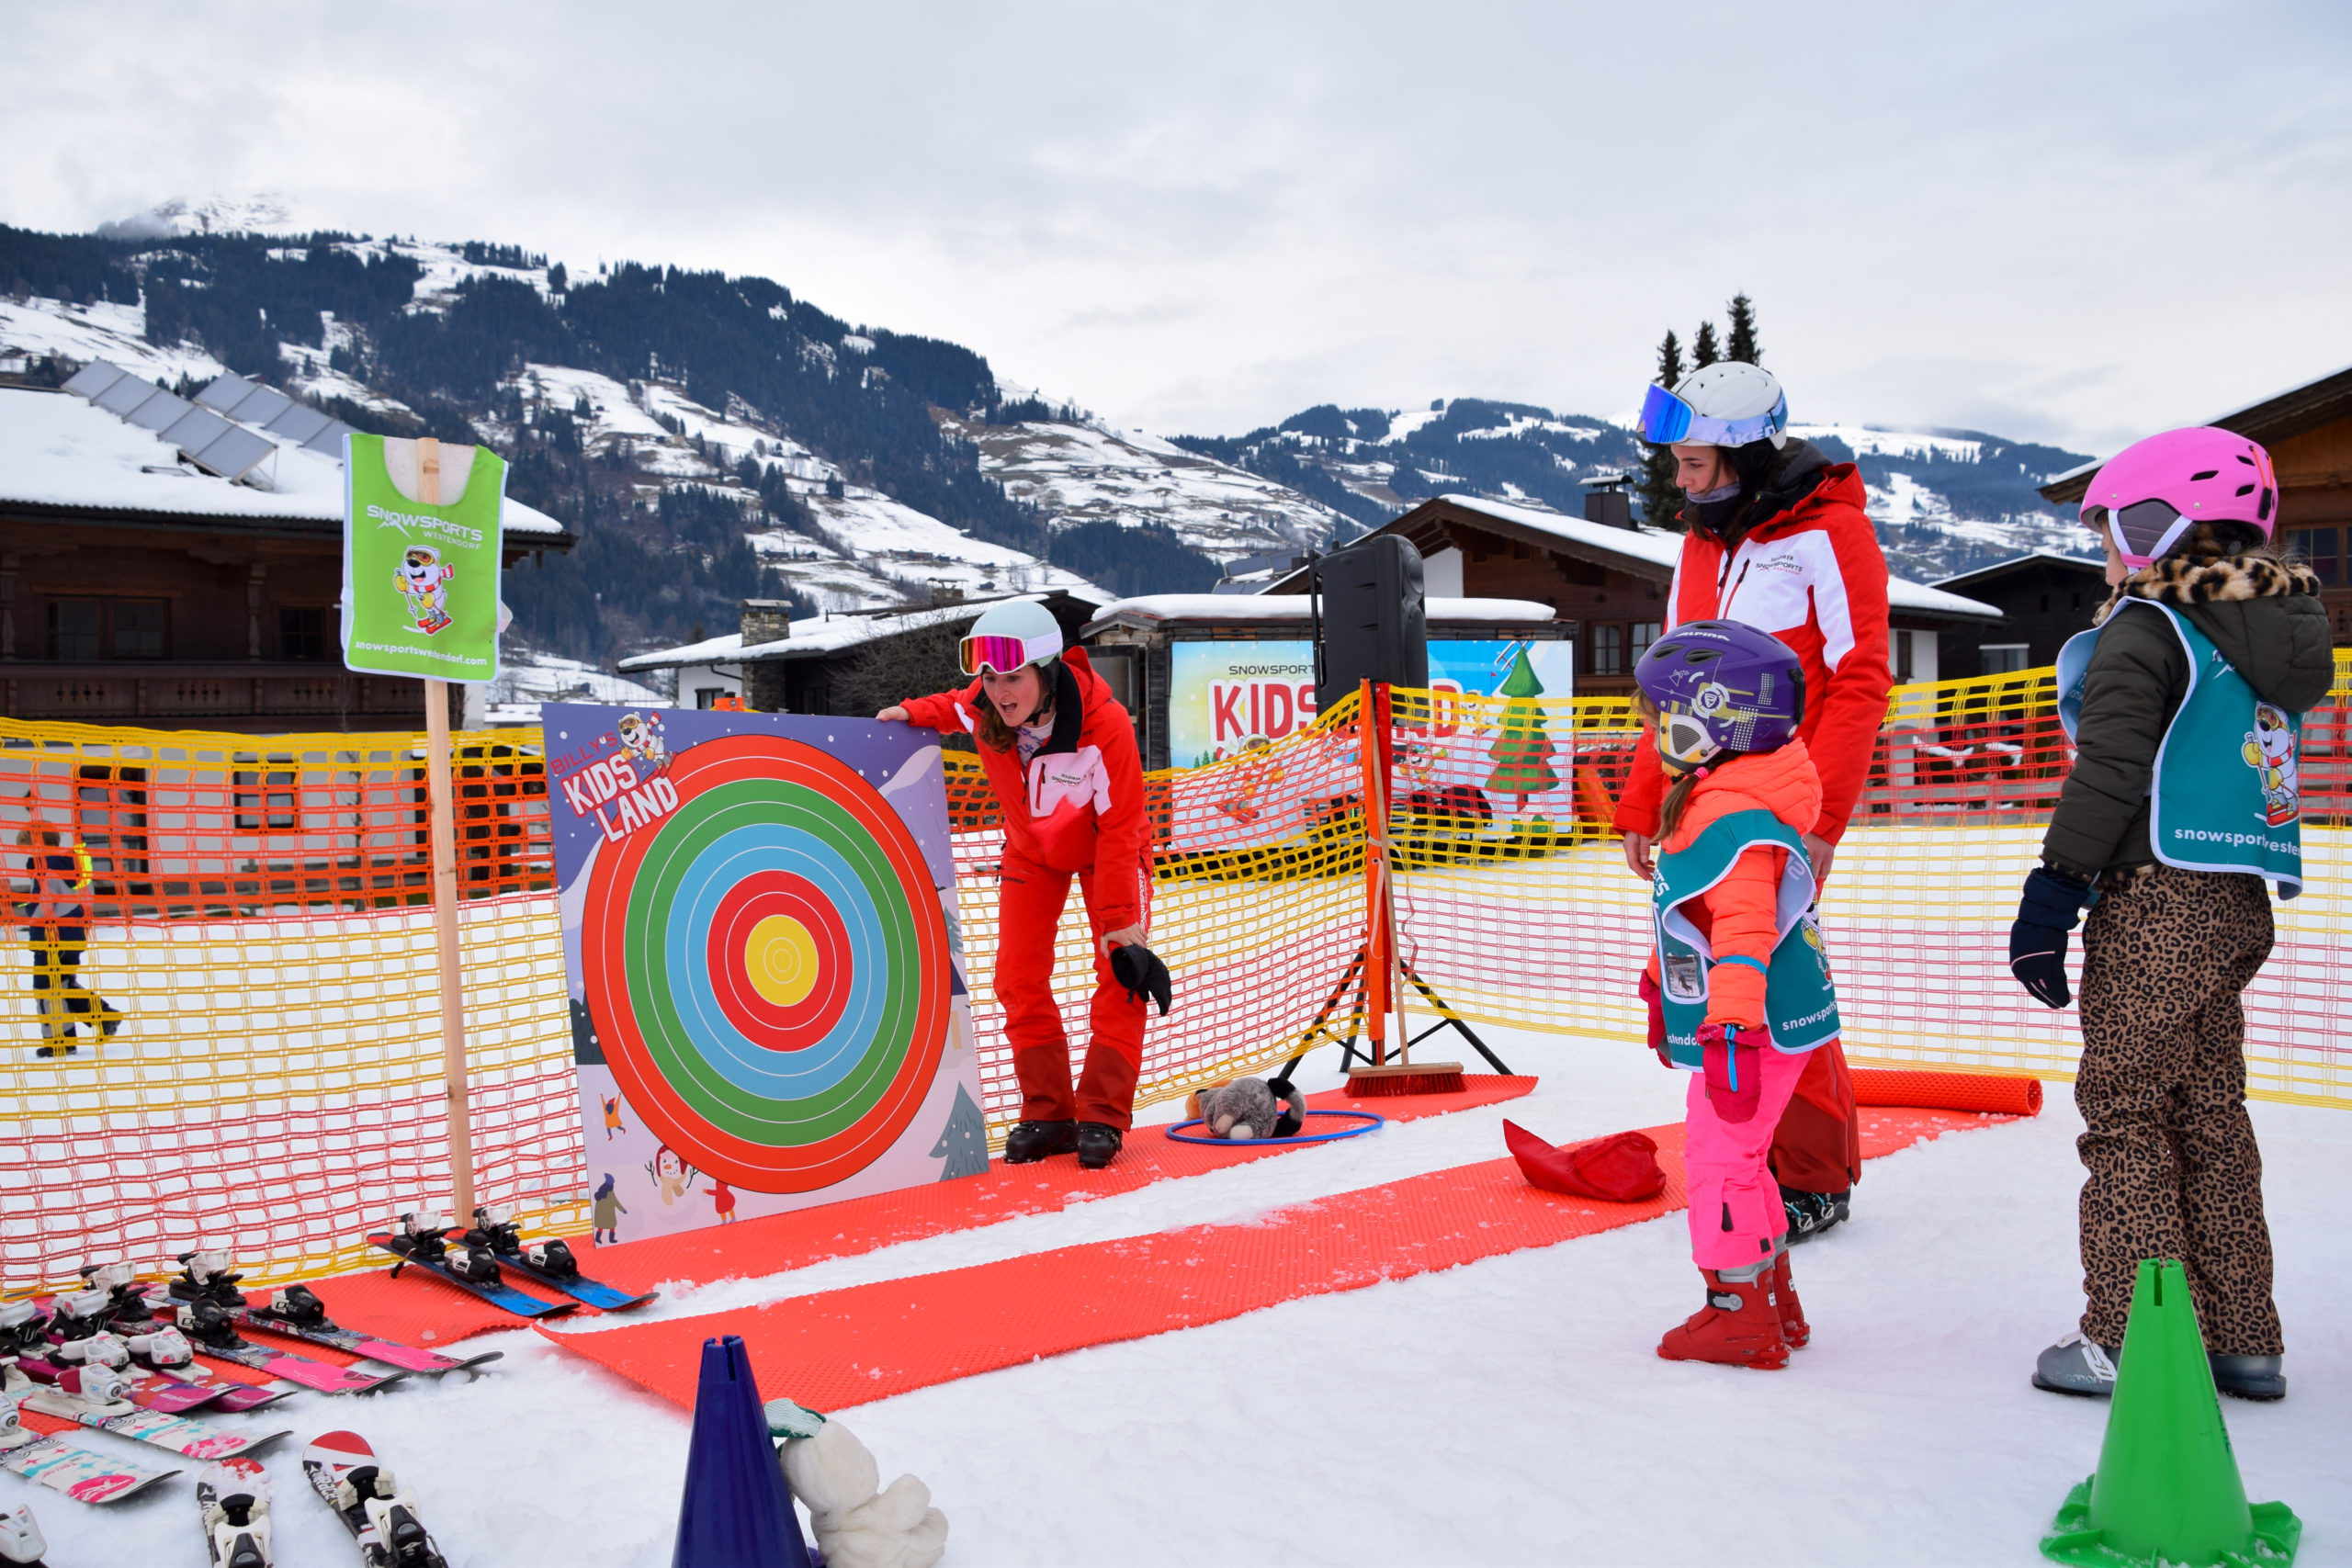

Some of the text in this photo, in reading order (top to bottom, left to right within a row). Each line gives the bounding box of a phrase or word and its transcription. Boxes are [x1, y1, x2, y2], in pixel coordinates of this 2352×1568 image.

[367, 504, 483, 542] SNOWSPORTS
[424, 530, 482, 549] WESTENDORF
[1228, 664, 1315, 675] SNOWSPORT
[549, 731, 617, 775] BILLY'S
[561, 752, 639, 816] KIDS
[595, 776, 679, 843] LAND
[1781, 999, 1838, 1032] snowsports
